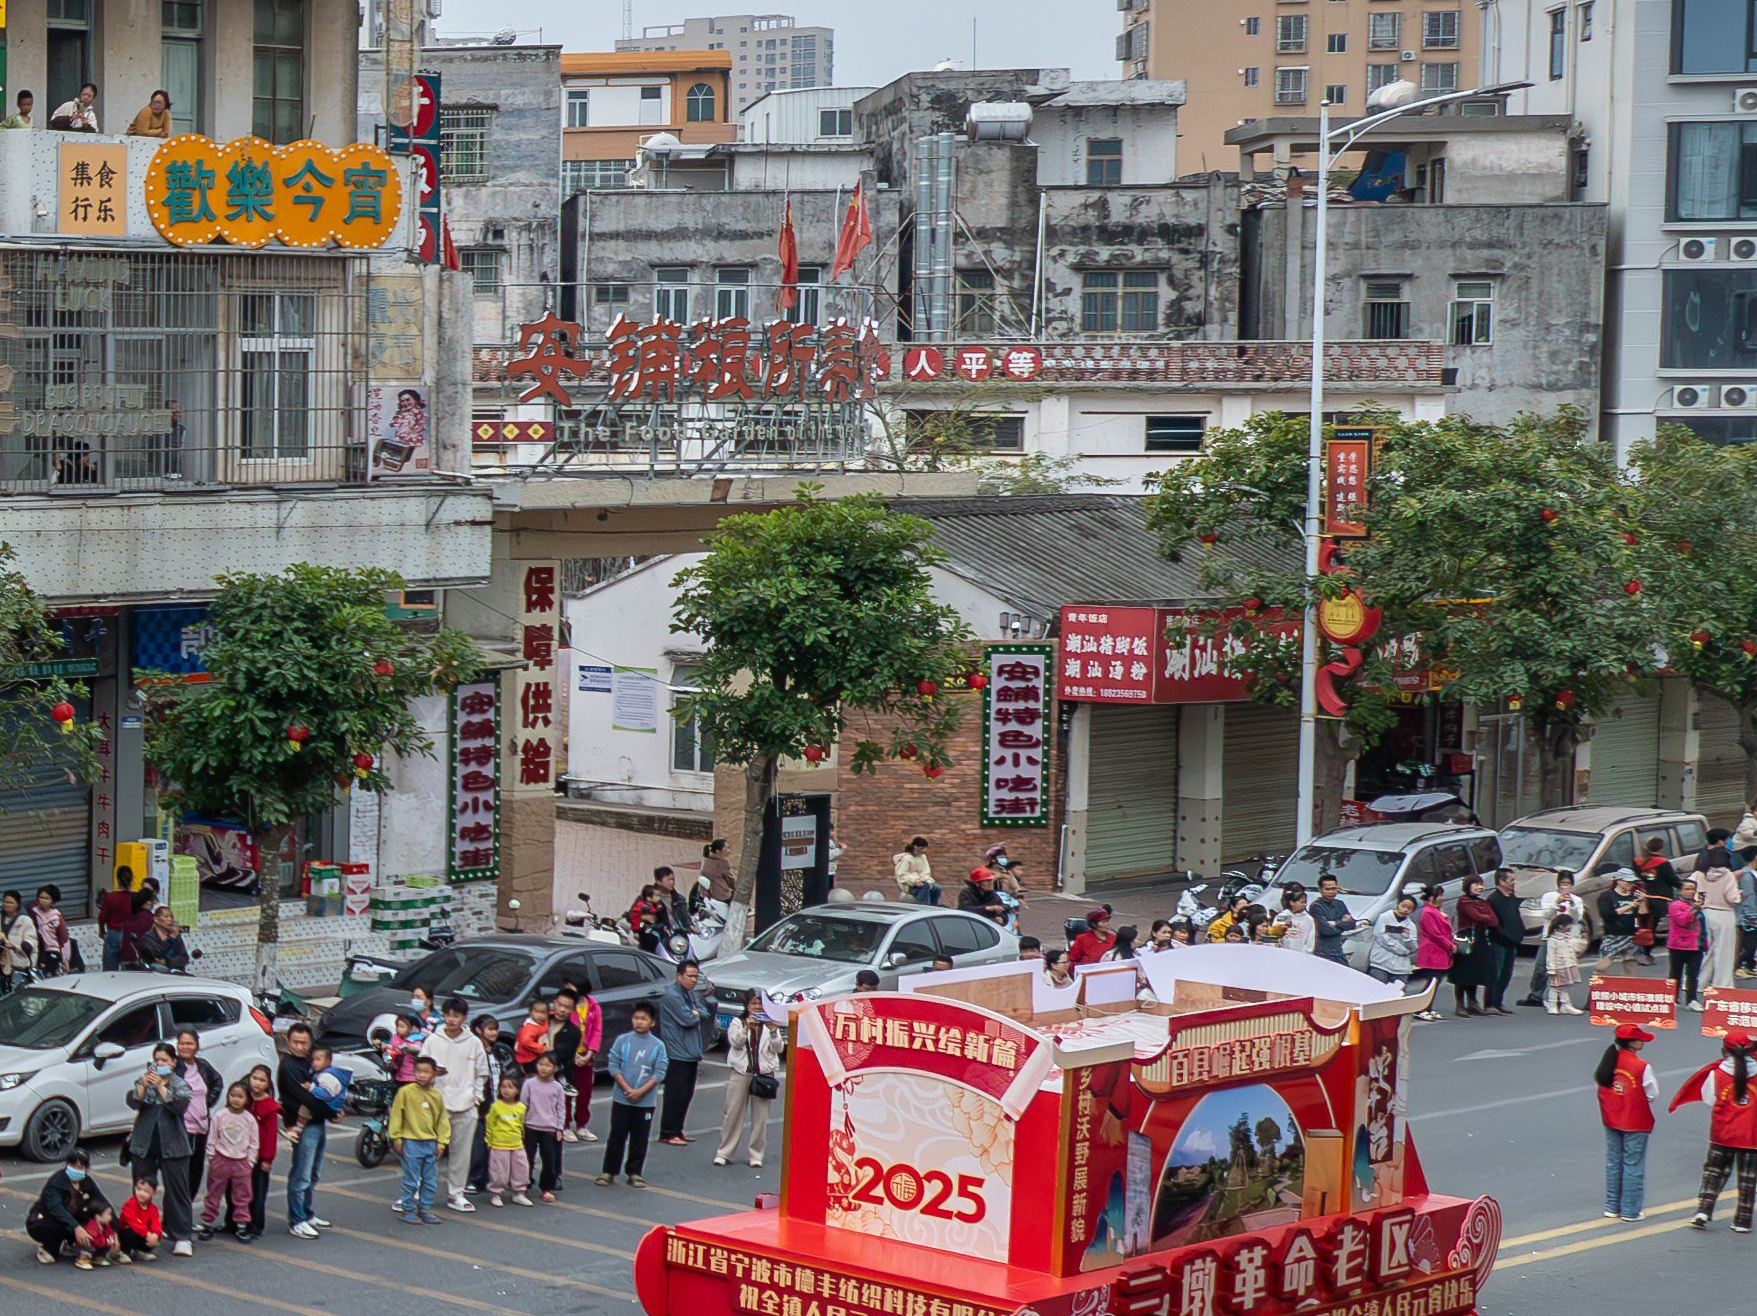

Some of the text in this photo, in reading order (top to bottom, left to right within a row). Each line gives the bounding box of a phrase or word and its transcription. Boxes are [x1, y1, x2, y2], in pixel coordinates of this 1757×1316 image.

[162, 158, 387, 227] 歡樂今宵
[833, 1012, 1019, 1072] 万村振兴绘新篇
[848, 1156, 987, 1225] 2025
